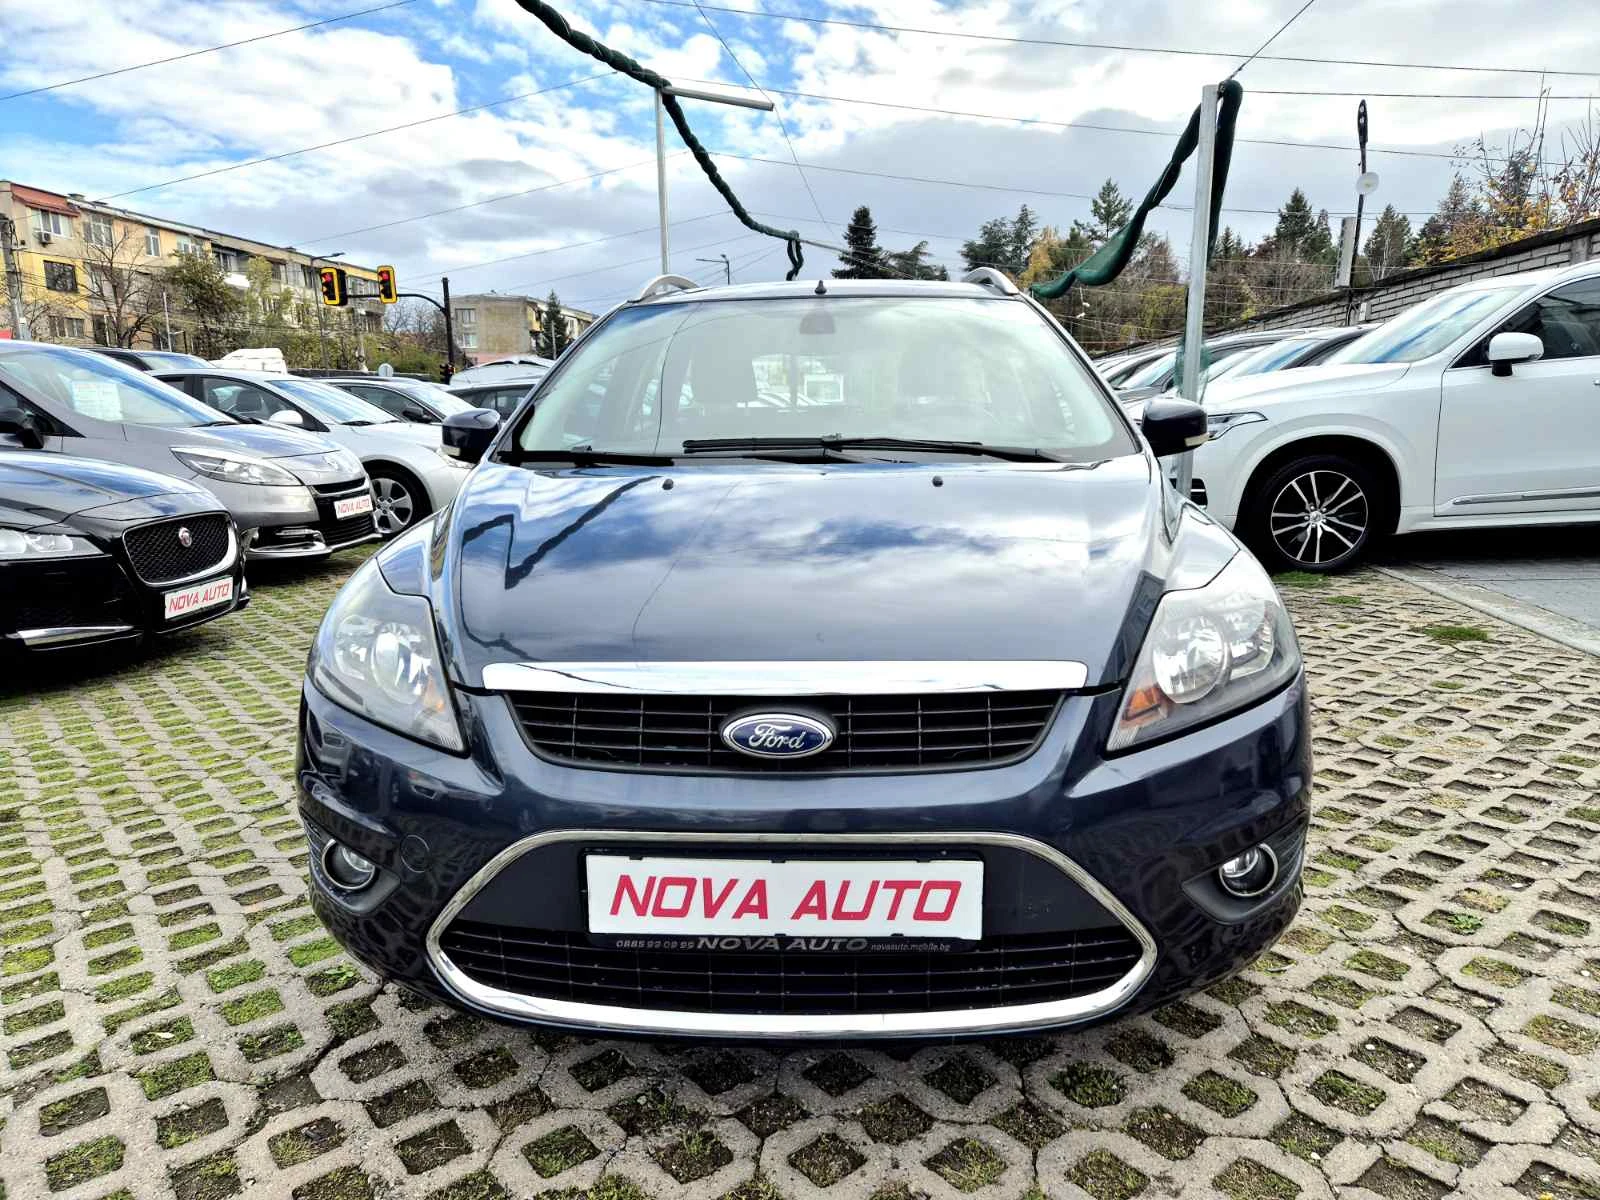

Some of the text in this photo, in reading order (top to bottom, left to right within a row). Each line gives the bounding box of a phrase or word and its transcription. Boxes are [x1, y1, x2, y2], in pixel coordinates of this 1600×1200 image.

[168, 583, 230, 612] NOVA AUTO
[748, 723, 805, 749] Ford
[609, 874, 962, 922] NOVA AUTO
[697, 937, 780, 951] NOVA
[786, 938, 868, 951] AUTO
